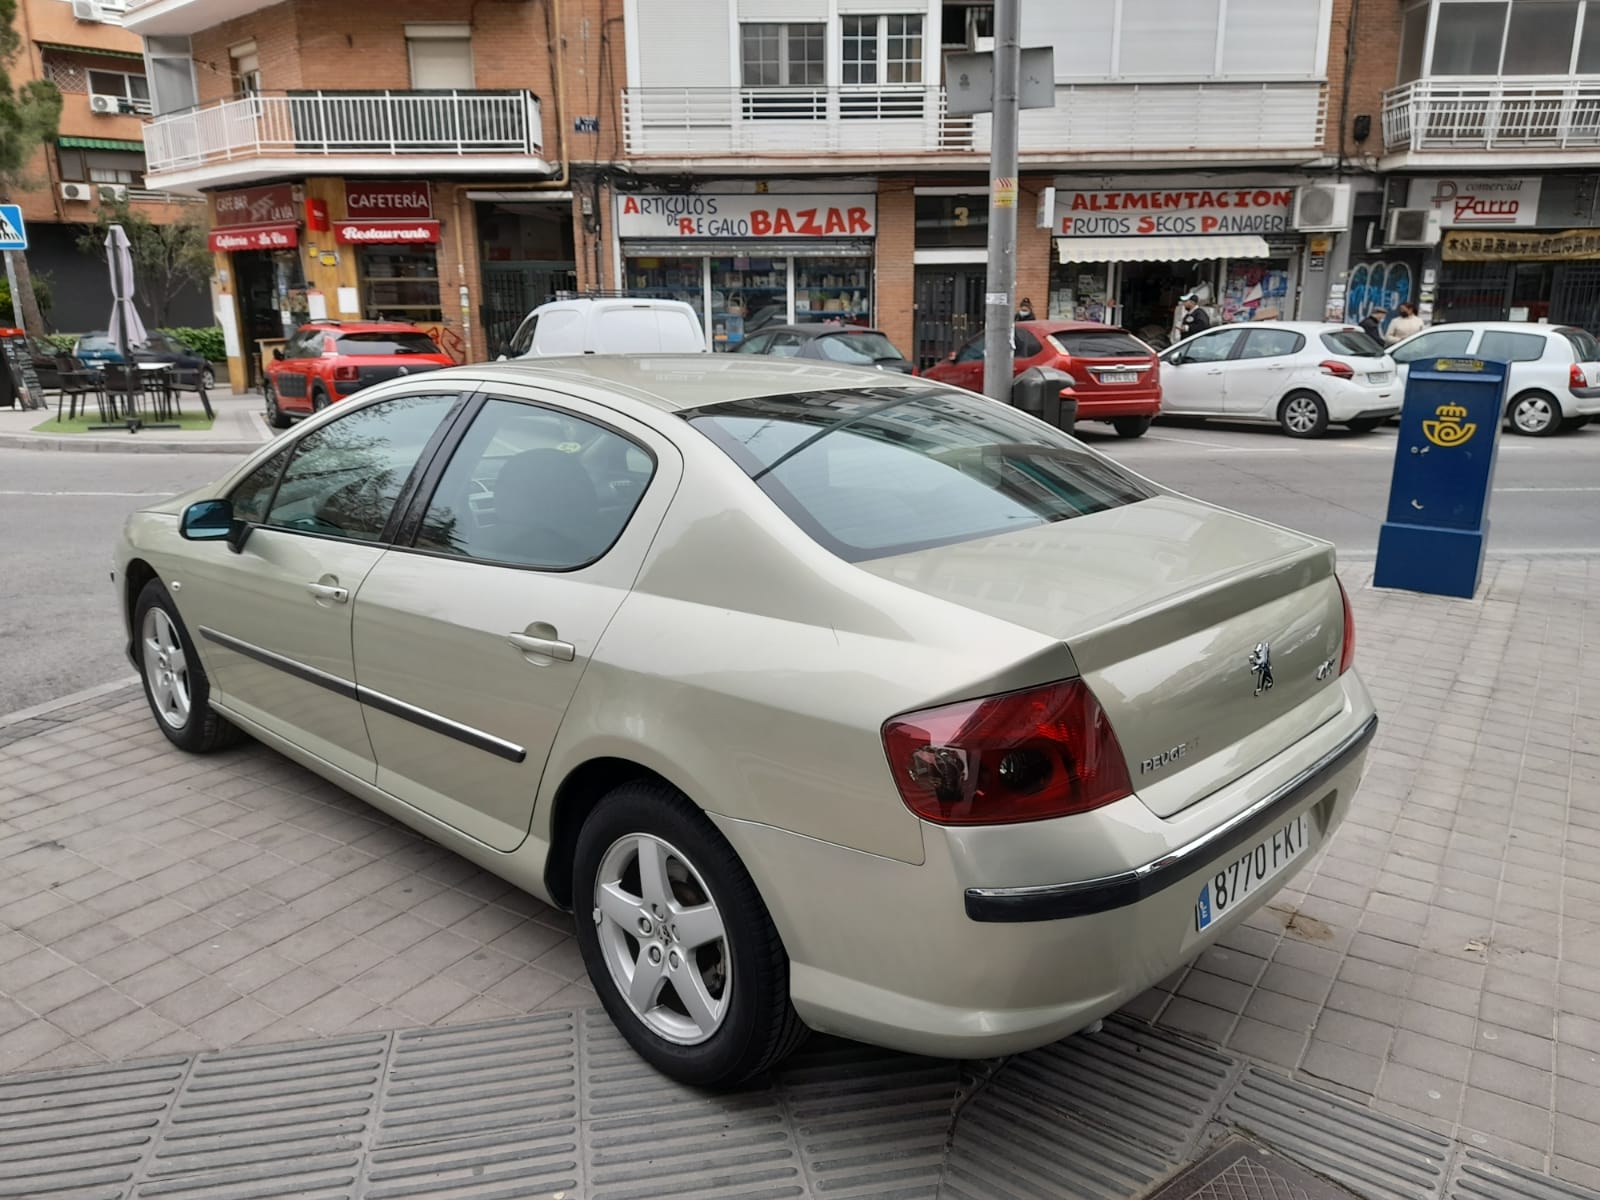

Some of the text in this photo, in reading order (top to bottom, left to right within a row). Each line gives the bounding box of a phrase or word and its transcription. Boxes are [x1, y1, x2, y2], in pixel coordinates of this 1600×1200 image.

[348, 191, 429, 209] CAFETERÍA
[623, 195, 718, 216] ARTICULOS
[1071, 189, 1291, 211] ALIMENTACION
[750, 207, 872, 236] BAZAR
[954, 207, 969, 226] 3
[1062, 217, 1130, 234] FRUTOS
[1137, 215, 1196, 234] SECOS
[342, 226, 431, 240] Restaurante
[1215, 843, 1266, 910] 8770
